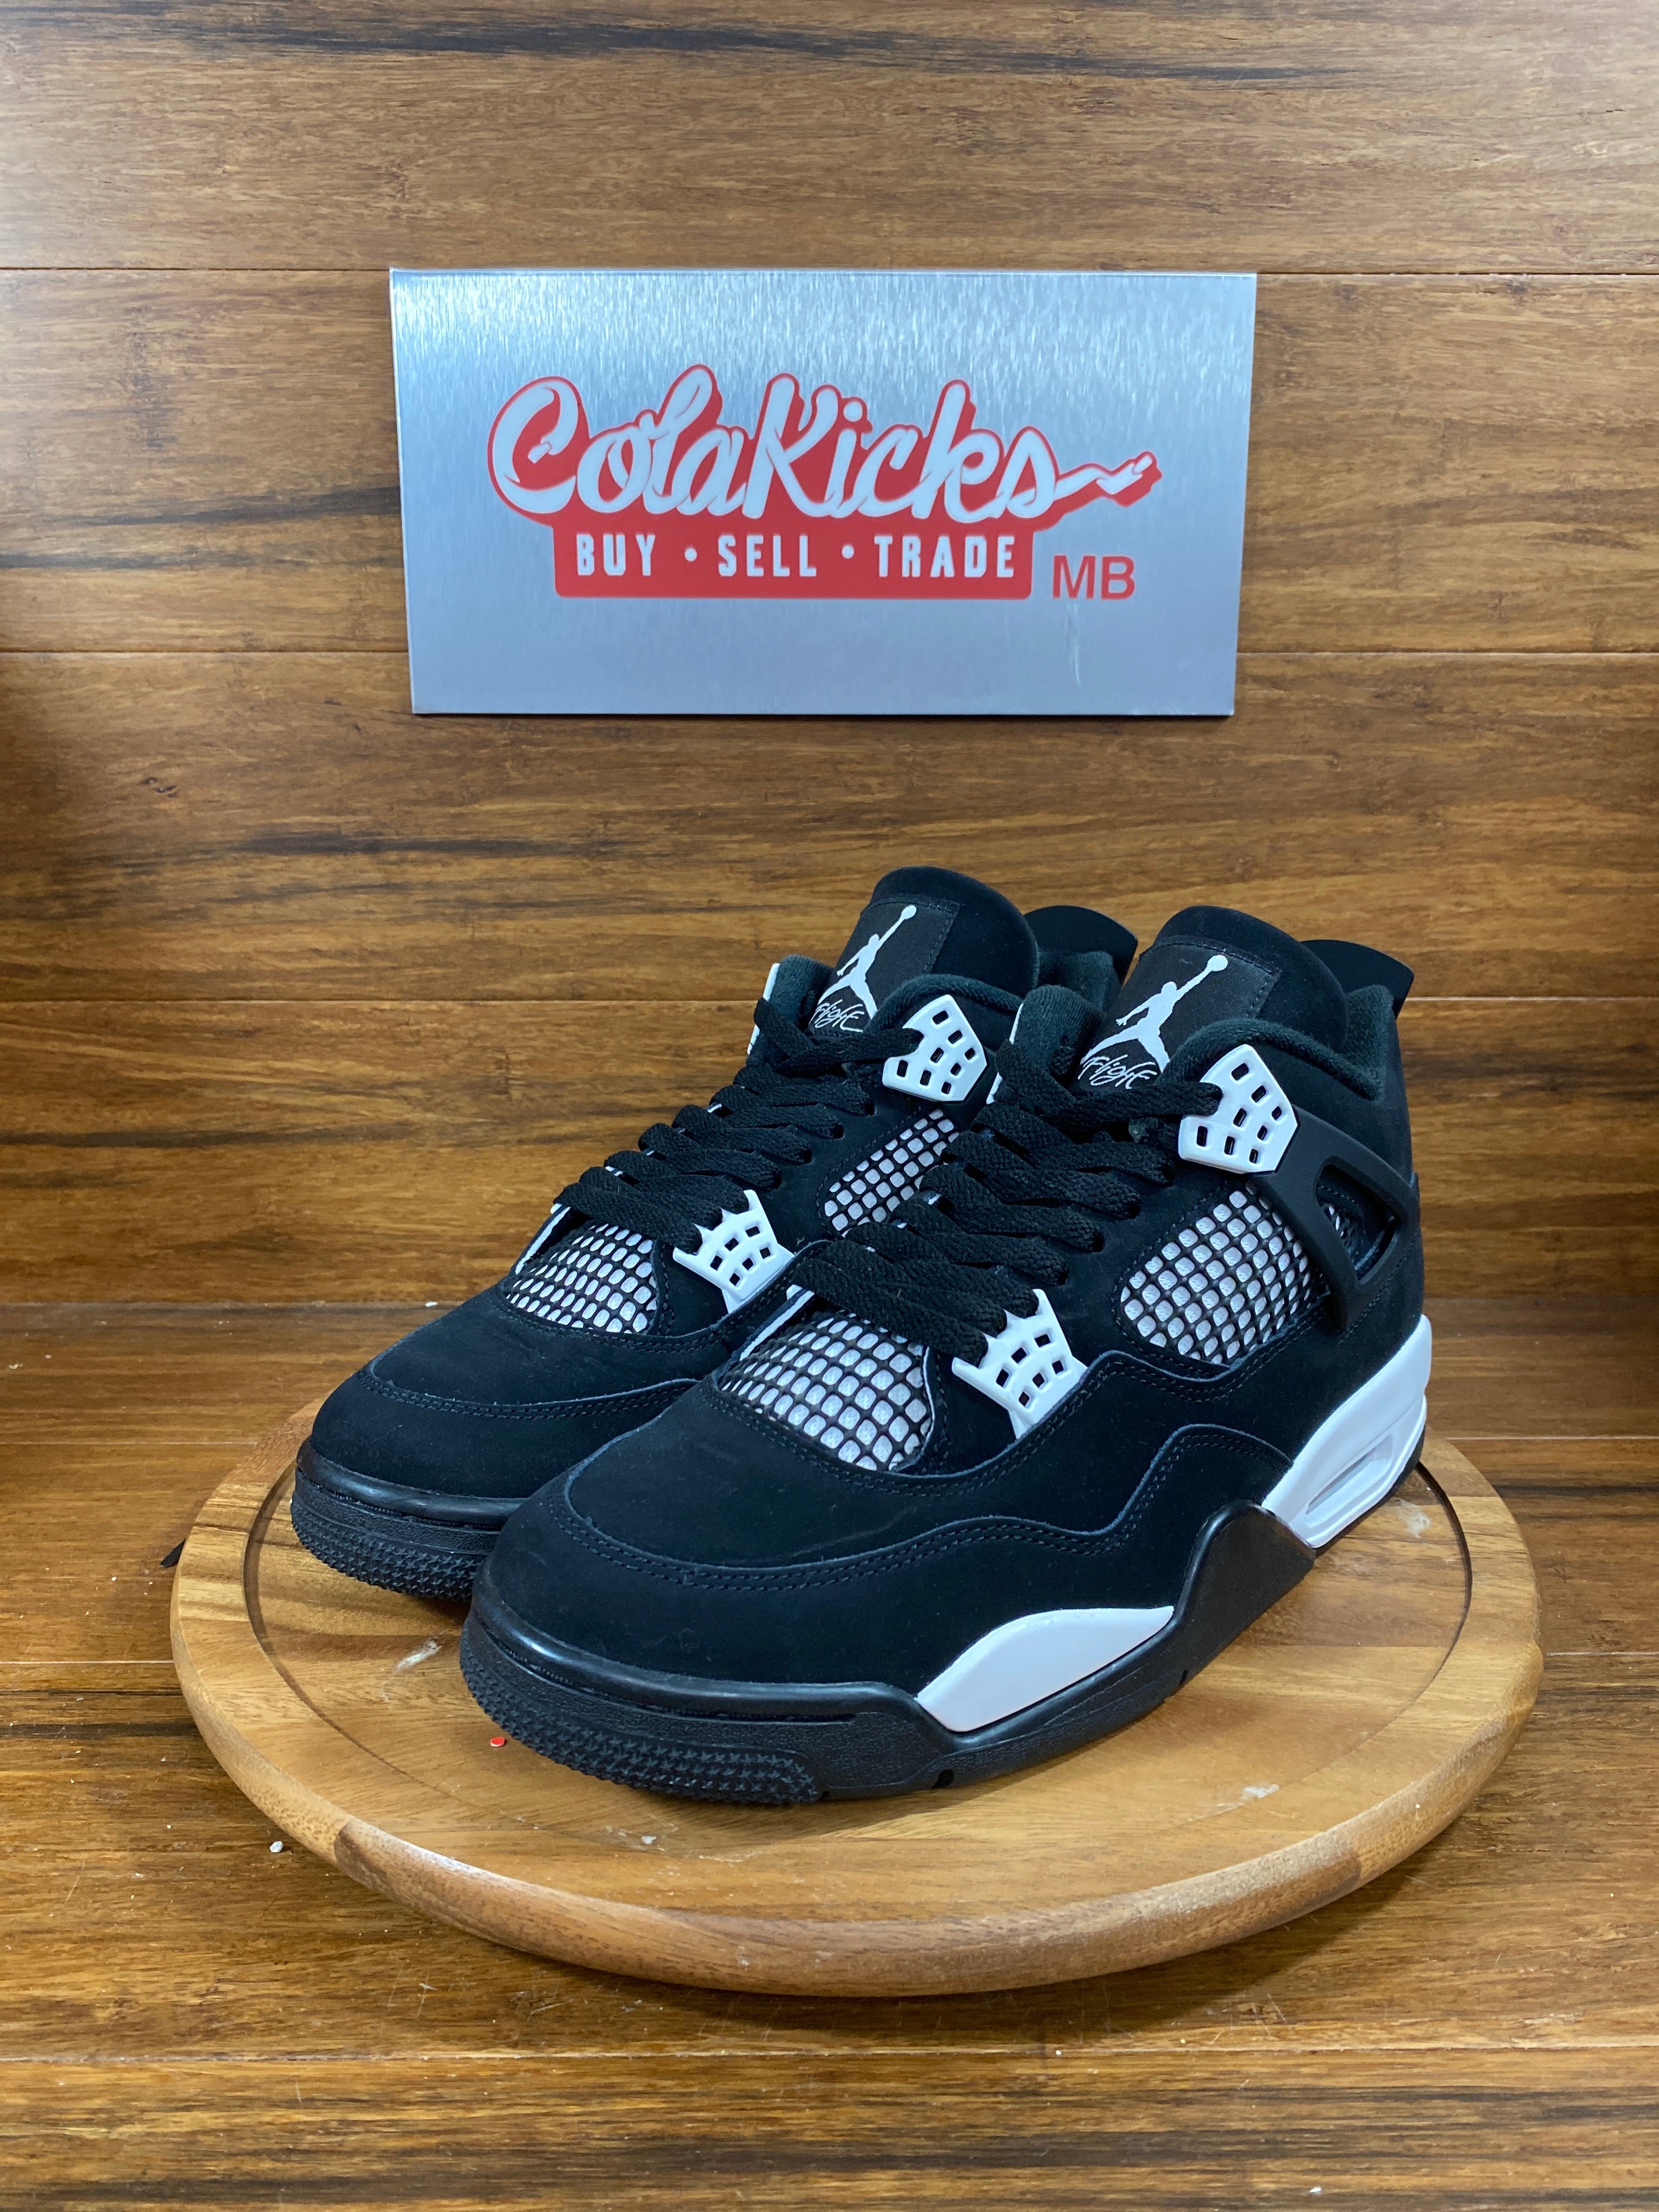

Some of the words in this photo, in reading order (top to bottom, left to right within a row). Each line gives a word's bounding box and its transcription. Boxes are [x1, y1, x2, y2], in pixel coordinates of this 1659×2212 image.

[488, 364, 1162, 524] ColaKicks
[575, 533, 656, 577] BUY
[717, 534, 817, 578] SELL
[873, 534, 1015, 578] TRADE
[1052, 554, 1135, 600] MB
